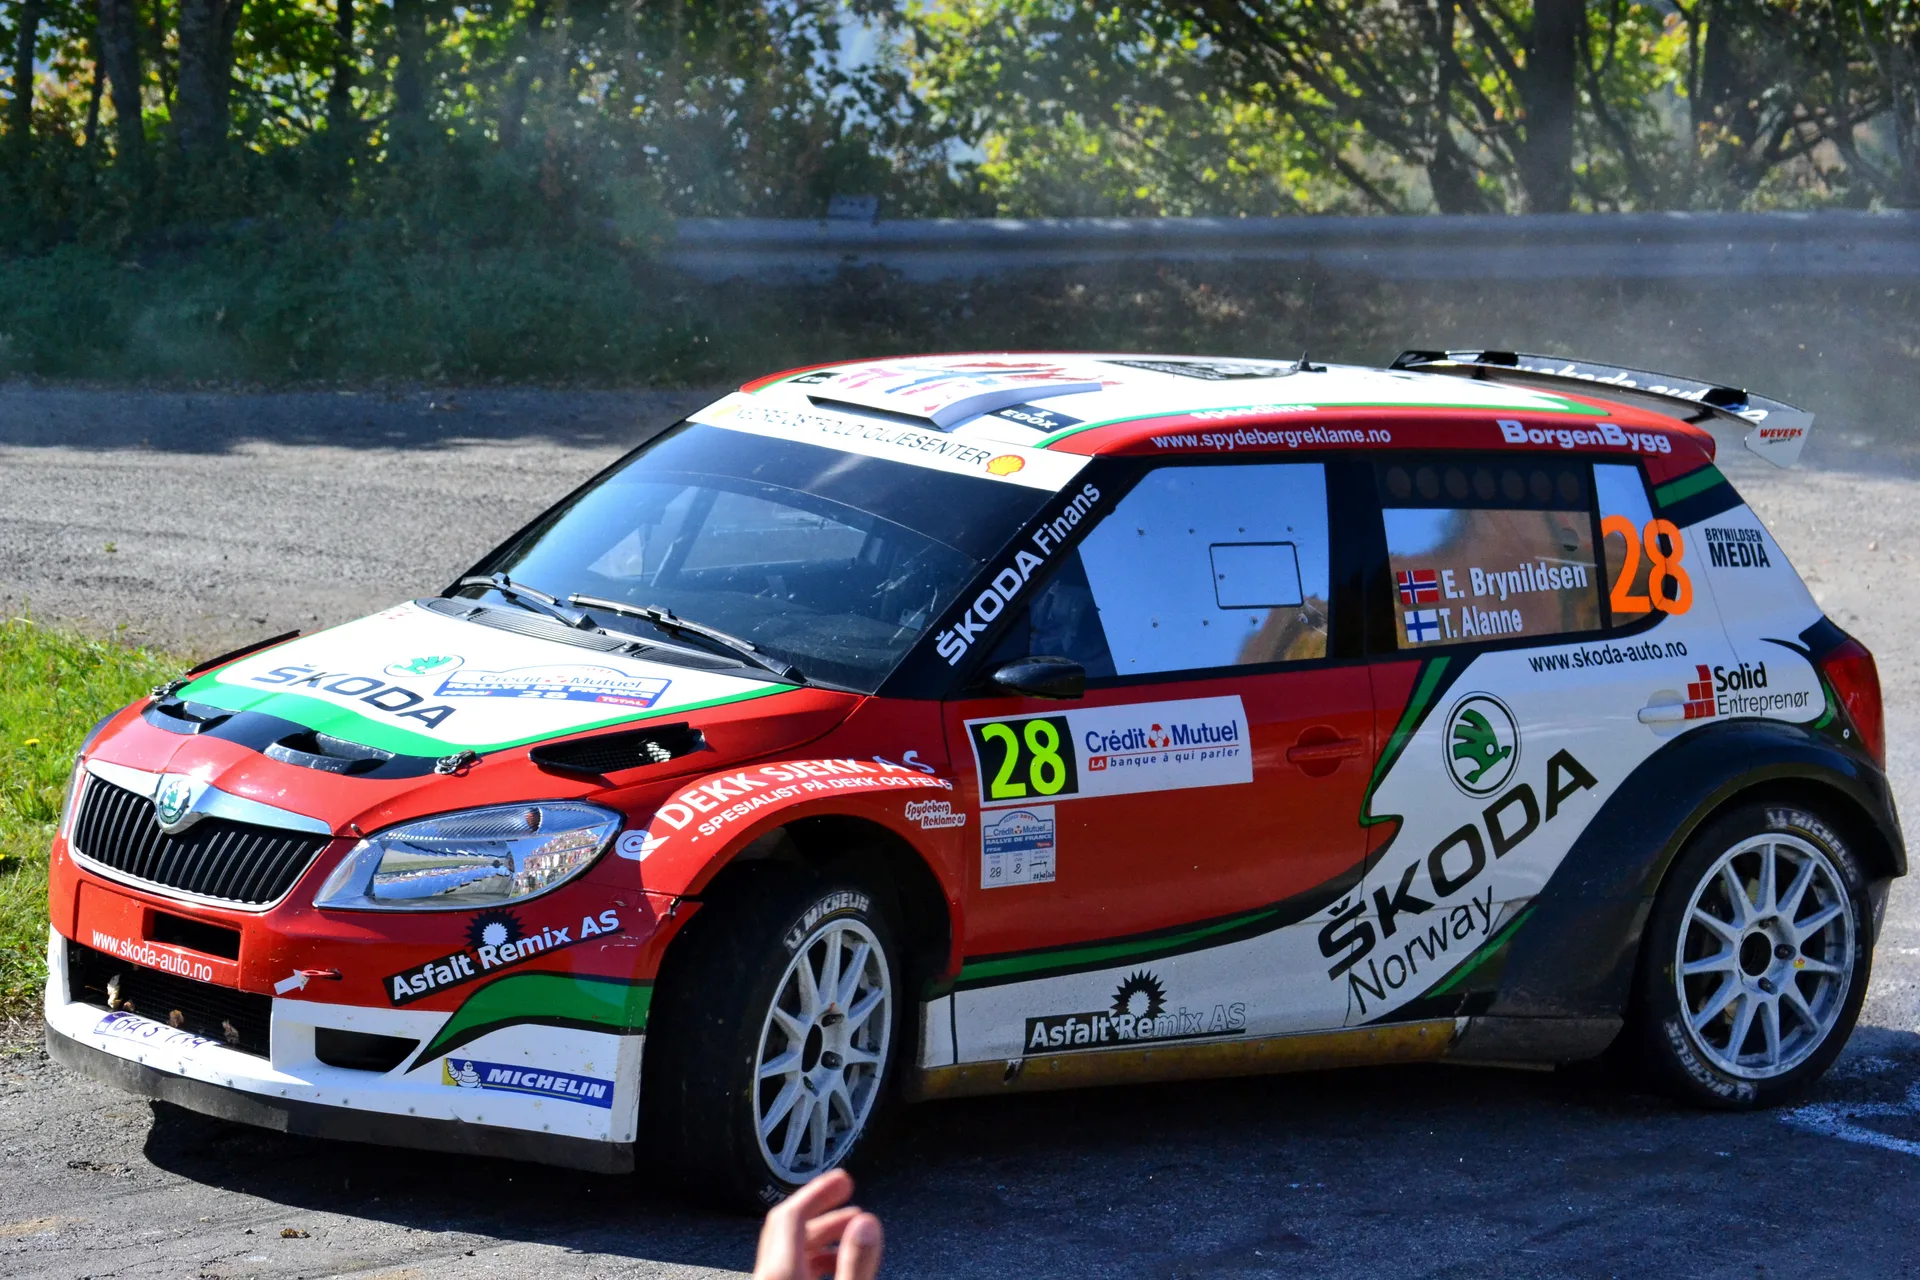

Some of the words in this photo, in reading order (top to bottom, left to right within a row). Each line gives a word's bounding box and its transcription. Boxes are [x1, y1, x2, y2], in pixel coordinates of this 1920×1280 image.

[1000, 408, 1058, 429] EDOX
[1760, 427, 1803, 438] WEVERS
[863, 427, 991, 465] OLJESENTER
[1150, 426, 1392, 450] www.spydebergreklame.no
[1496, 418, 1672, 454] BorgenBygg
[1704, 527, 1762, 542] BRYNILDSEN
[1601, 514, 1692, 615] 28
[1708, 542, 1771, 568] MEDIA
[935, 550, 1044, 666] ŠKODA
[1032, 483, 1100, 555] Finans
[1440, 569, 1465, 599] E.
[1471, 562, 1587, 601] Brynildsen
[1440, 609, 1458, 639] T.
[1462, 605, 1523, 638] Alanne
[1528, 640, 1688, 673] www.skoda-auto.no
[446, 683, 532, 691] RALLYE
[569, 686, 656, 698] FRANCE
[570, 677, 642, 688] Mutuel
[1714, 661, 1768, 692] Solid
[251, 663, 457, 730] ŠKODA
[517, 690, 568, 699] 28
[600, 697, 645, 706] TOTAL
[1717, 691, 1809, 716] Entreprenør
[1085, 728, 1148, 754] Crédit
[1171, 719, 1239, 746] Mutuel
[981, 719, 1066, 799] 28
[1090, 758, 1106, 769] LA
[1110, 755, 1156, 769] banque
[1163, 752, 1169, 763] à
[1175, 750, 1195, 764] qui
[1201, 747, 1240, 761] parler
[655, 772, 768, 830] DEKK
[762, 758, 873, 783] SJEKK
[871, 750, 936, 774] AS
[701, 786, 802, 837] SPESIALIST
[805, 777, 828, 793] PÅ
[831, 775, 878, 790] DEKK
[883, 776, 909, 786] OG
[907, 776, 954, 791] FELG
[906, 801, 950, 818] Spydeberg
[922, 815, 956, 827] Reklame
[993, 827, 1014, 837] Crédit
[1023, 824, 1046, 833] Mutuel
[1025, 833, 1052, 841] FRANCE
[990, 866, 1002, 878] 28
[1318, 748, 1599, 981] ŠKODA
[803, 892, 870, 932] MICHELIN
[92, 928, 213, 982] www.skoda-auto.no
[393, 955, 475, 1001] Asfalt
[477, 926, 572, 970] Remix
[580, 909, 620, 939] AS
[1349, 884, 1493, 1015] Norway
[1029, 1016, 1110, 1049] Asfalt
[1118, 1007, 1204, 1040] Remix
[1208, 1002, 1247, 1031] AS
[486, 1067, 607, 1099] MICHELIN
